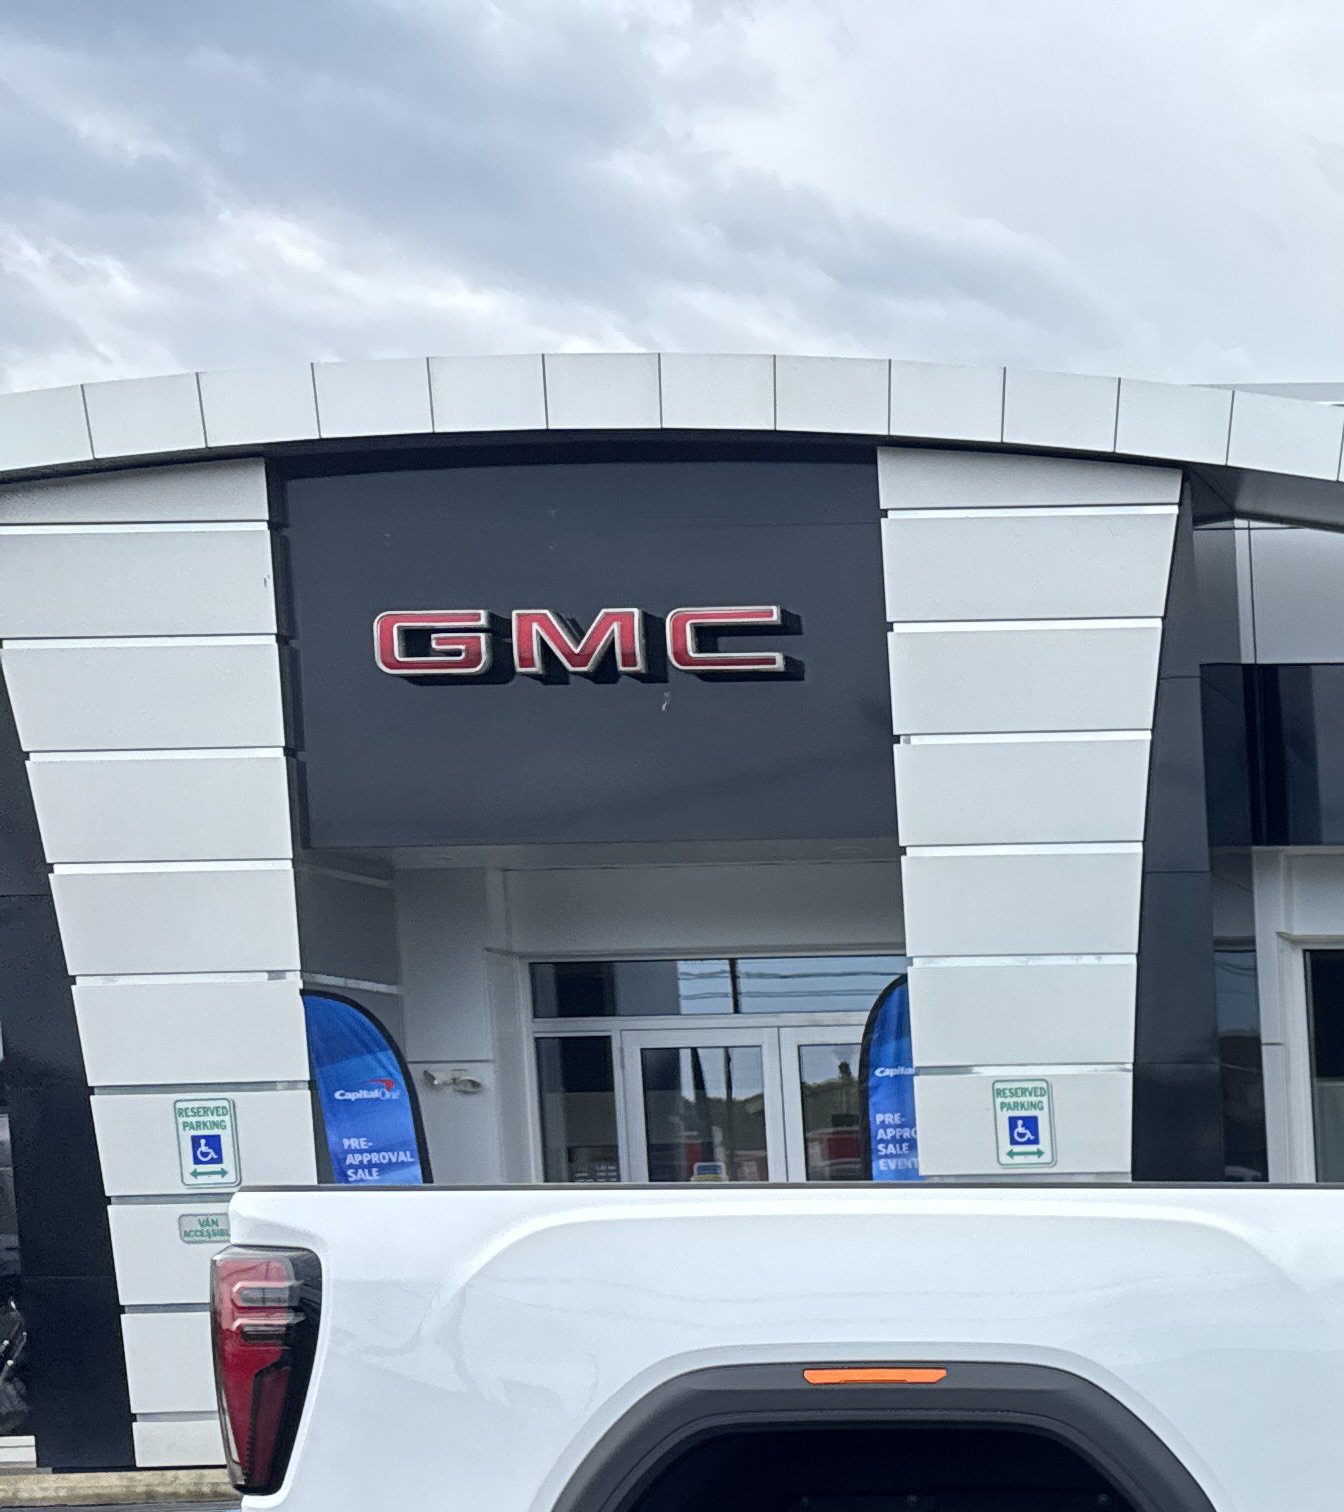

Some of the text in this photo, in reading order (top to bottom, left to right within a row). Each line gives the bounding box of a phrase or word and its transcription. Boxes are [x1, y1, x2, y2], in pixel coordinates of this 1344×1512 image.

[373, 605, 785, 675] GMC
[995, 1086, 1047, 1099] RESERVED
[177, 1105, 229, 1118] RESERVED
[1000, 1100, 1044, 1112] PARKING
[875, 1113, 906, 1125] PRE-
[182, 1120, 227, 1132] PARKING
[876, 1127, 918, 1140] APPRO
[342, 1137, 373, 1150] PRE-
[877, 1143, 910, 1156] SALE
[345, 1151, 416, 1166] APPROVAL
[346, 1167, 380, 1182] SALE
[197, 1217, 219, 1228] VAN
